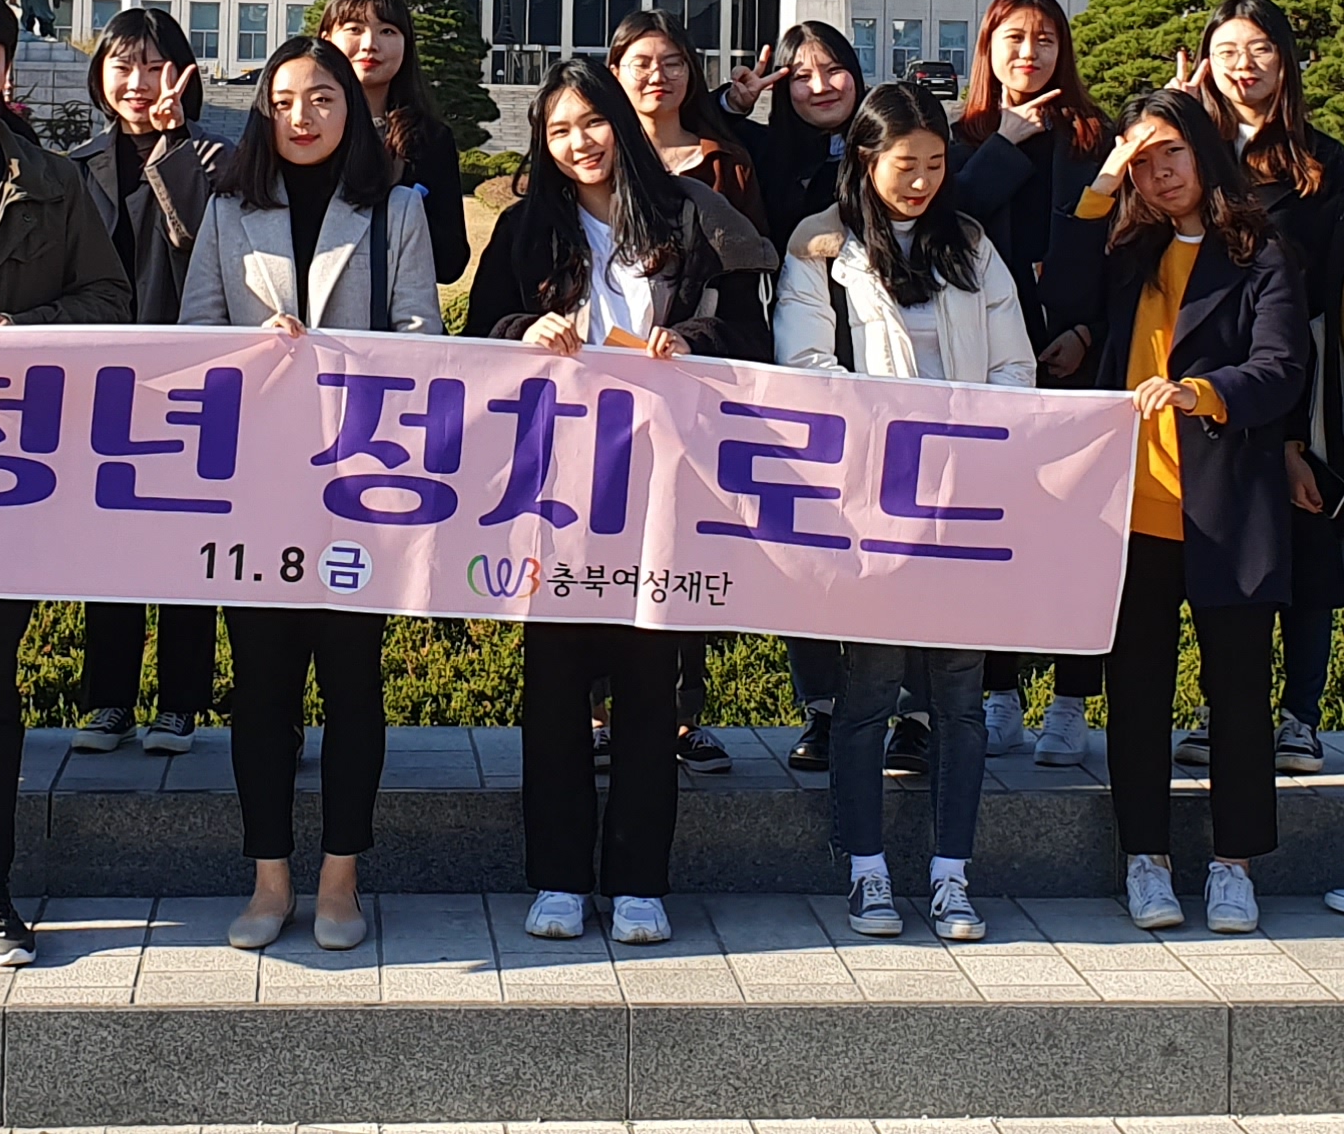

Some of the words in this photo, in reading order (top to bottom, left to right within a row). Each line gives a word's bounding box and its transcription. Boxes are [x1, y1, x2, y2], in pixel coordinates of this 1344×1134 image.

[309, 372, 635, 536] 정치
[696, 400, 1014, 562] 로드
[325, 546, 366, 589] 금
[546, 562, 734, 606] 충북여성재단
